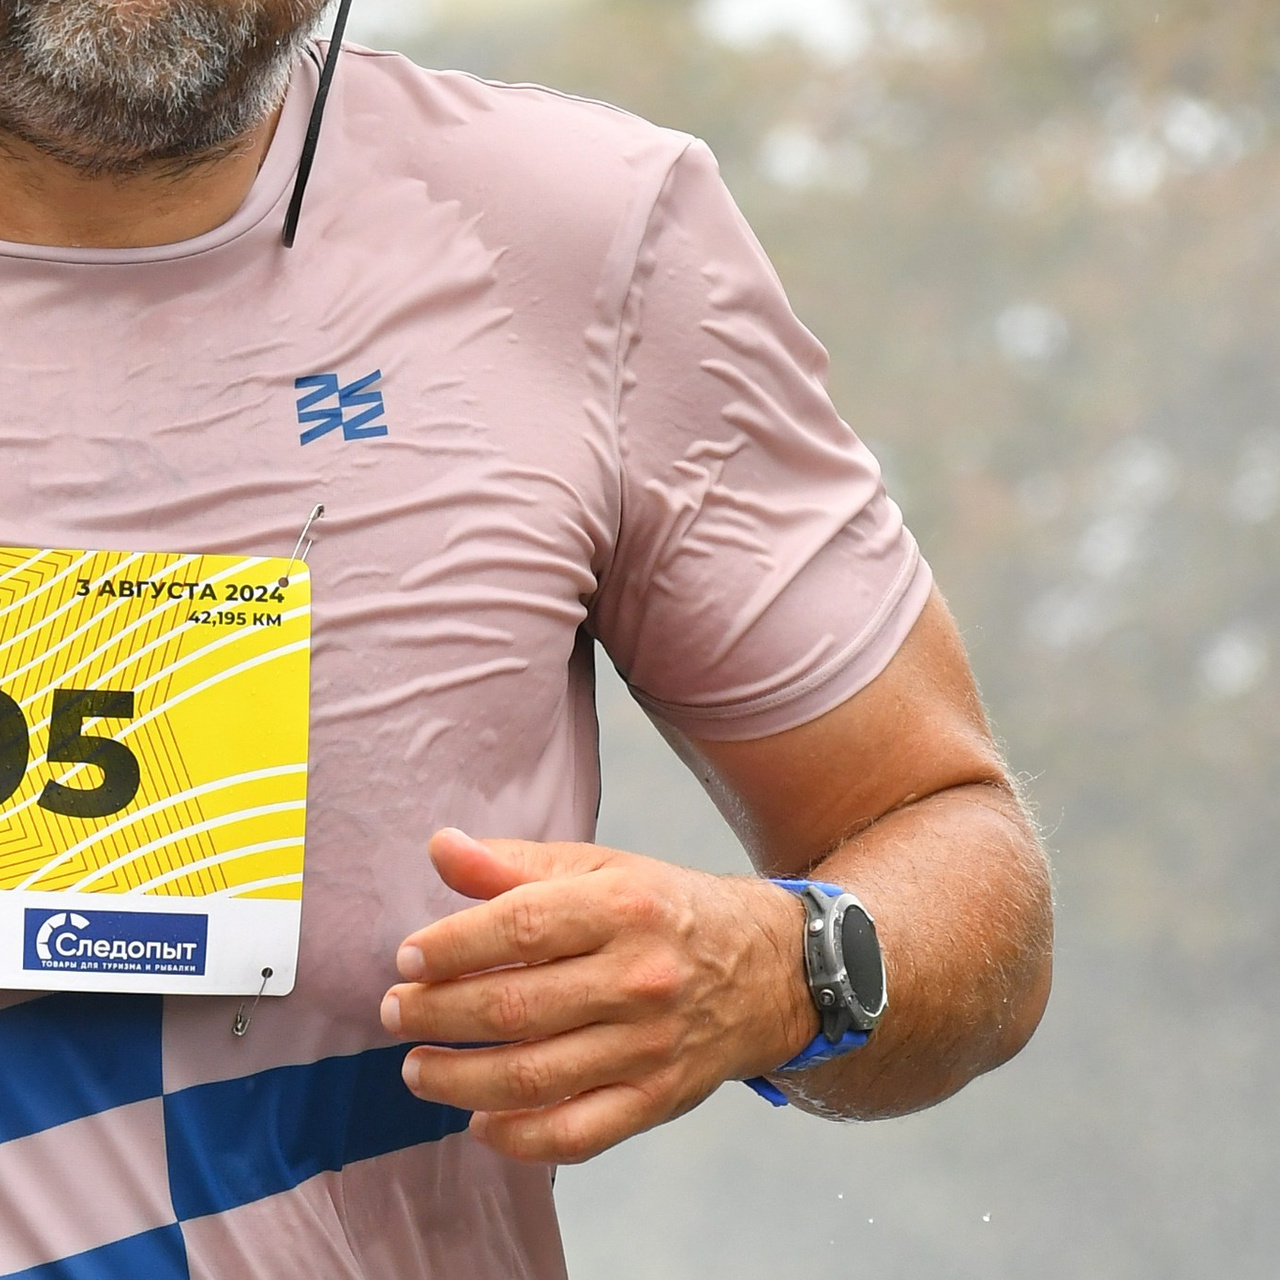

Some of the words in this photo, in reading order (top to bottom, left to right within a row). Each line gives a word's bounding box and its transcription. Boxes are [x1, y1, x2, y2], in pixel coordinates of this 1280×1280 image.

[76, 579, 91, 597] 3
[98, 580, 218, 601] АВГУСТА
[225, 584, 285, 603] 2024
[188, 610, 247, 627] 42,195
[253, 613, 282, 627] КМ
[55, 932, 198, 960] Следопыт
[41, 960, 77, 969] ТОВАРЫ
[81, 961, 98, 969] ДЛЯ
[102, 962, 142, 971] ТУРИЗМА
[145, 963, 151, 971] И
[154, 964, 196, 972] РЫБАЛКИ
